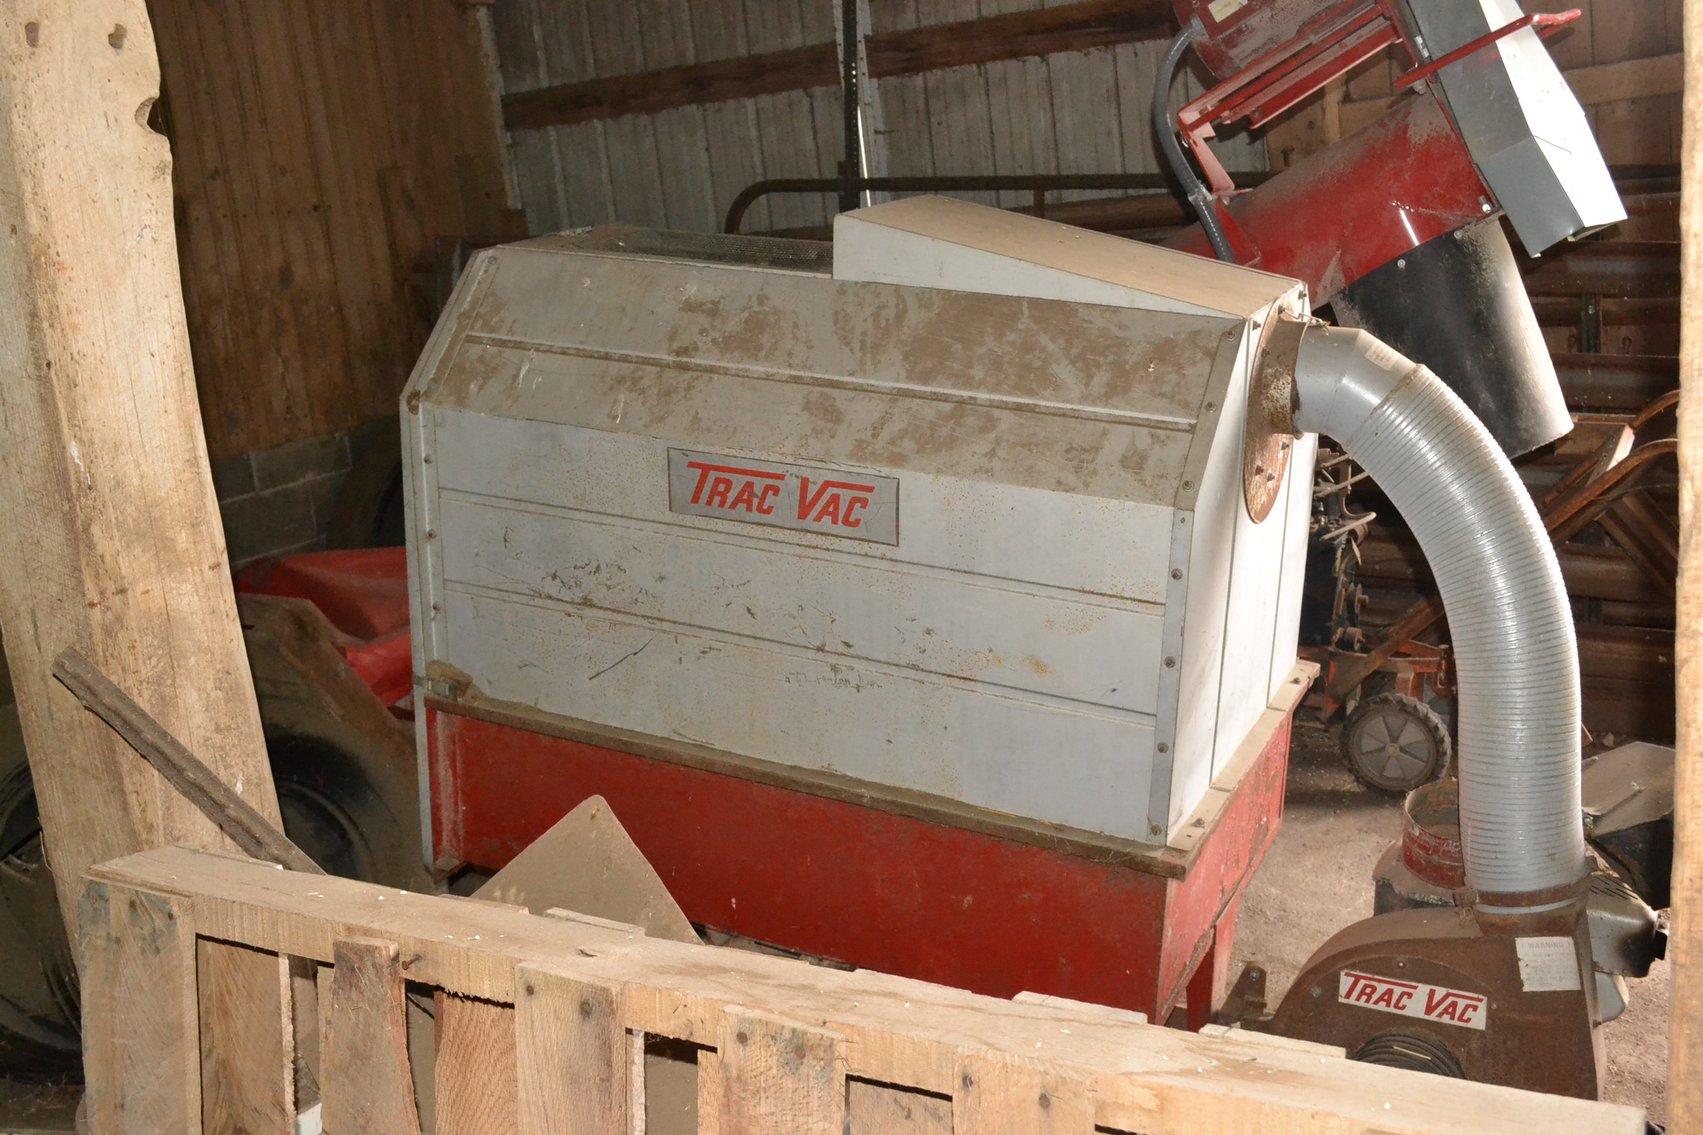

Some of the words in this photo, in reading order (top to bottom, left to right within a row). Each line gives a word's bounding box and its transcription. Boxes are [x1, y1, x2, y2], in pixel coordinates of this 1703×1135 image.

[687, 461, 786, 515] TRAC
[797, 477, 875, 528] VAC
[1344, 972, 1419, 1011] TRAC
[1424, 989, 1484, 1024] VAC
